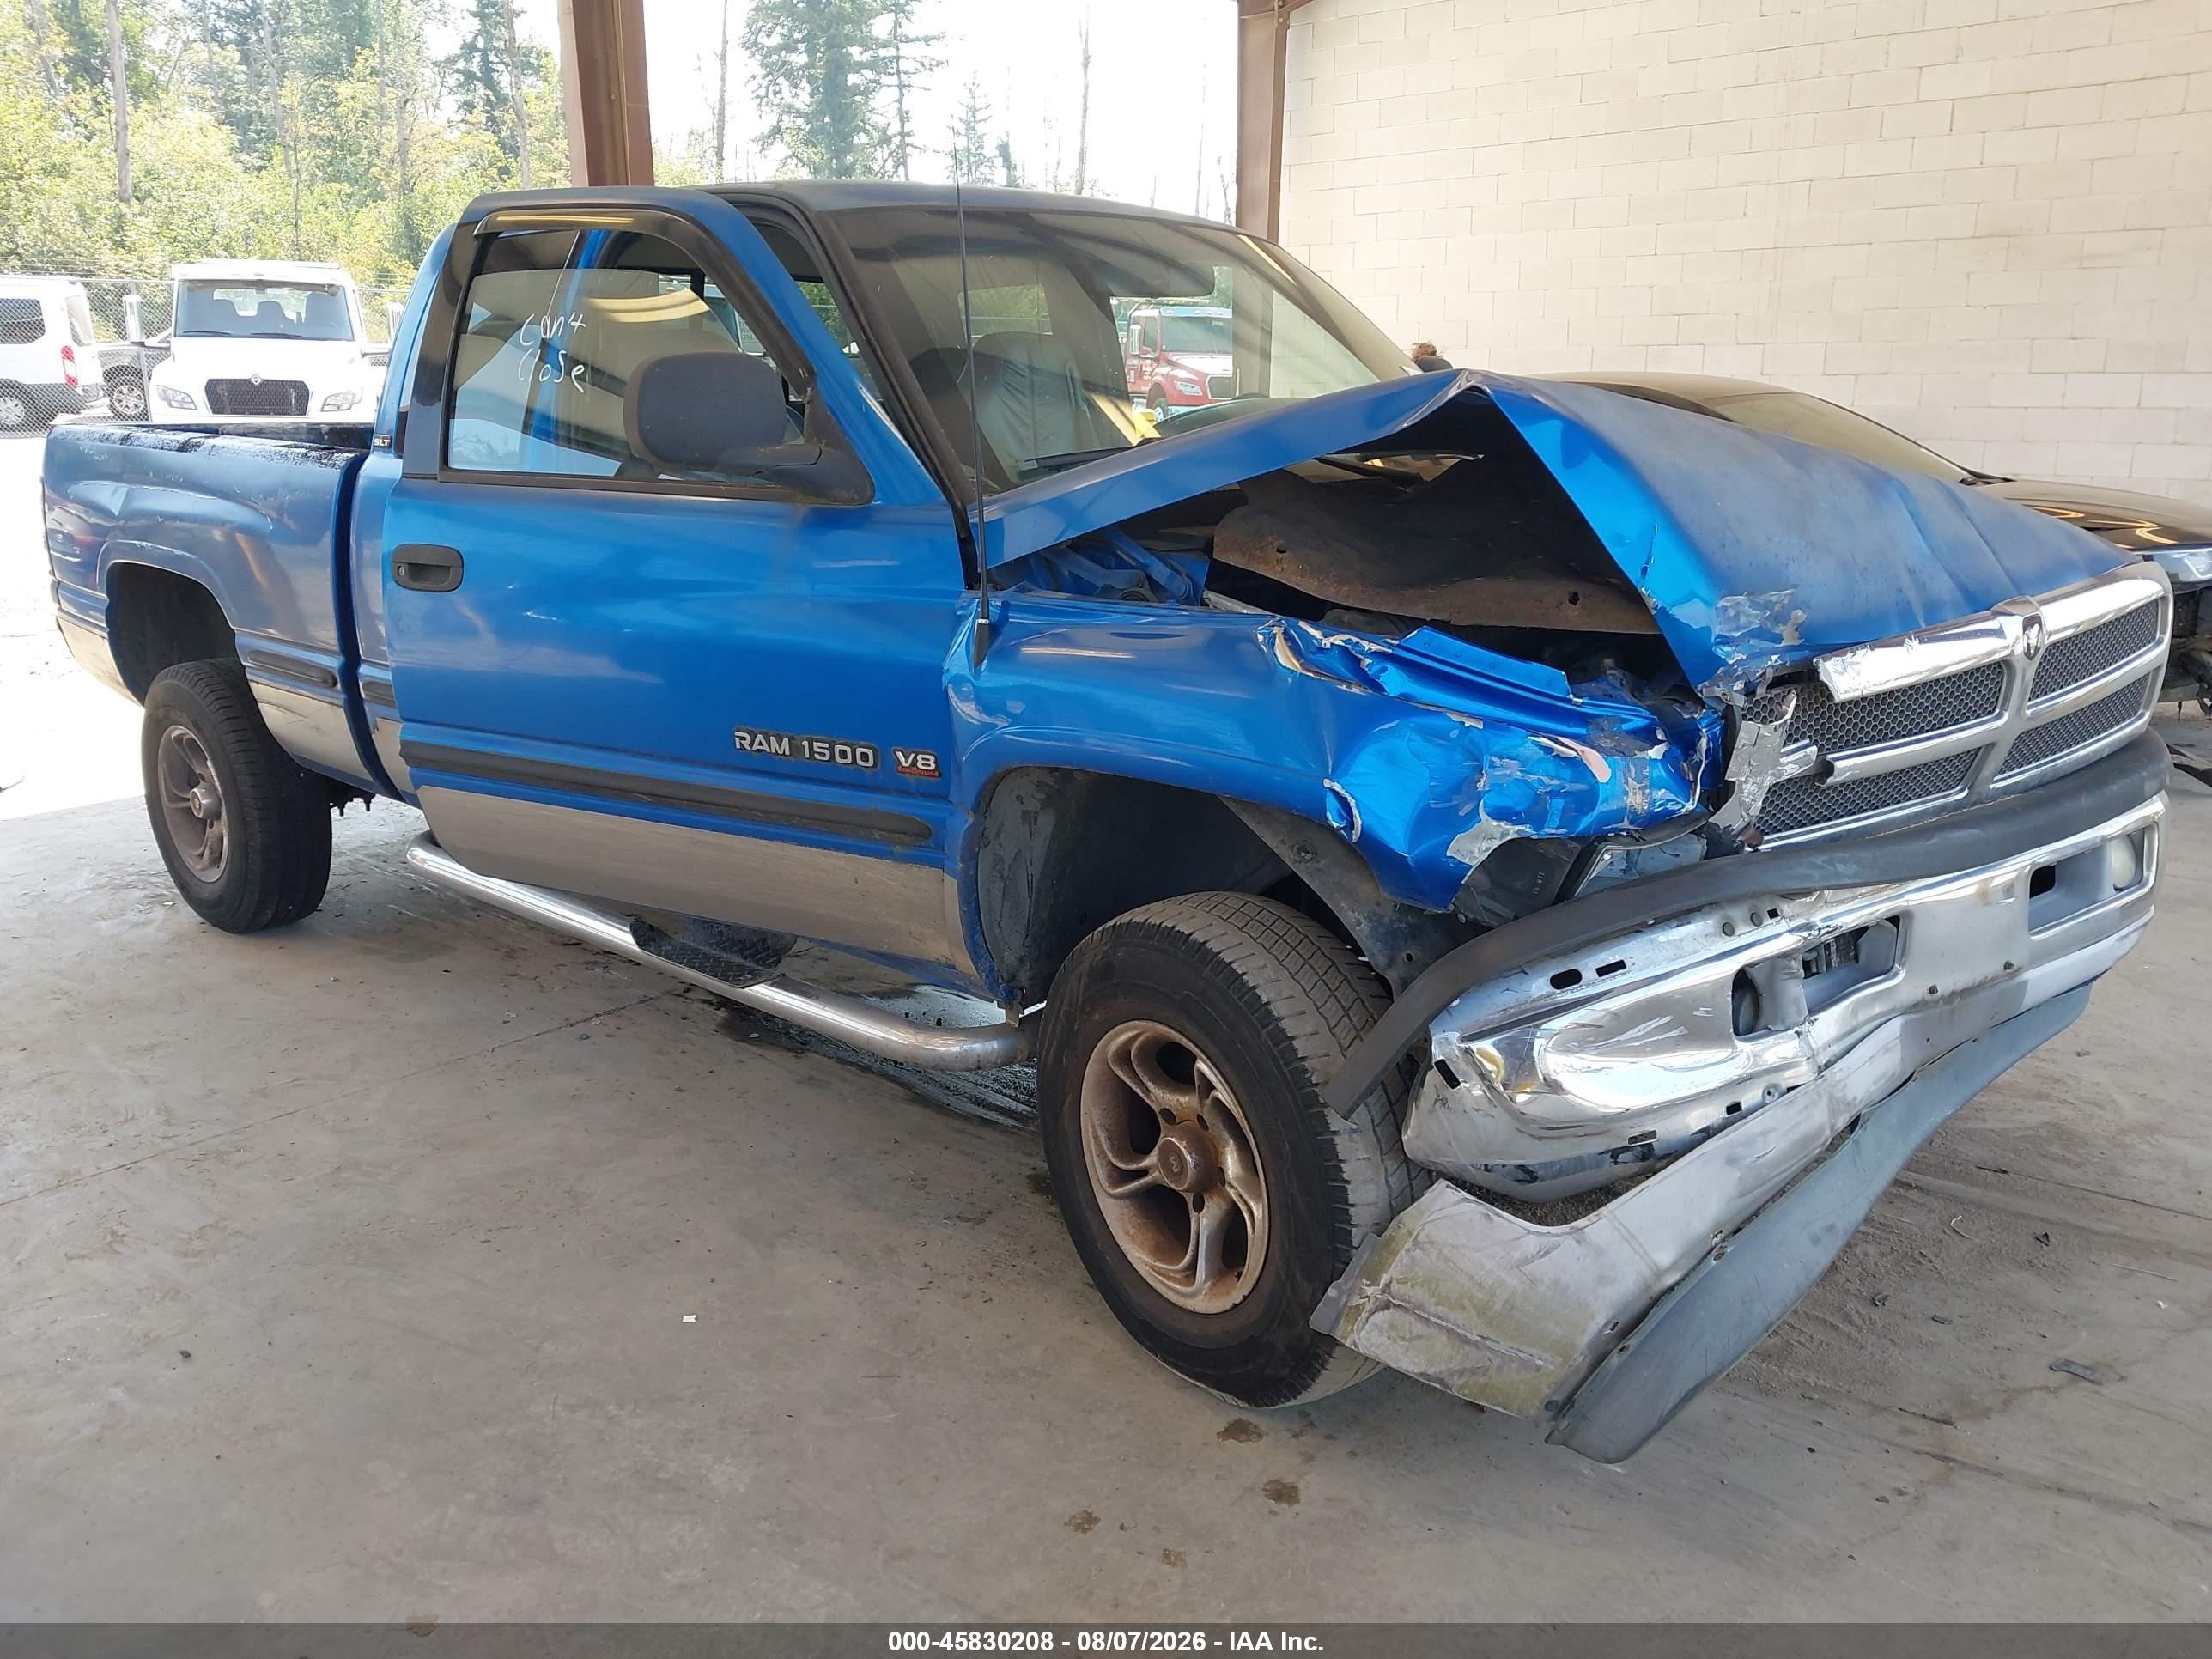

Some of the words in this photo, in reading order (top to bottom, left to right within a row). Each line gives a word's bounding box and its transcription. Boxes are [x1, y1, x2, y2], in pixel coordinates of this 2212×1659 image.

[374, 438, 391, 447] SLT
[734, 731, 790, 756] RAM
[800, 740, 874, 768] 1500
[894, 750, 936, 770] V8
